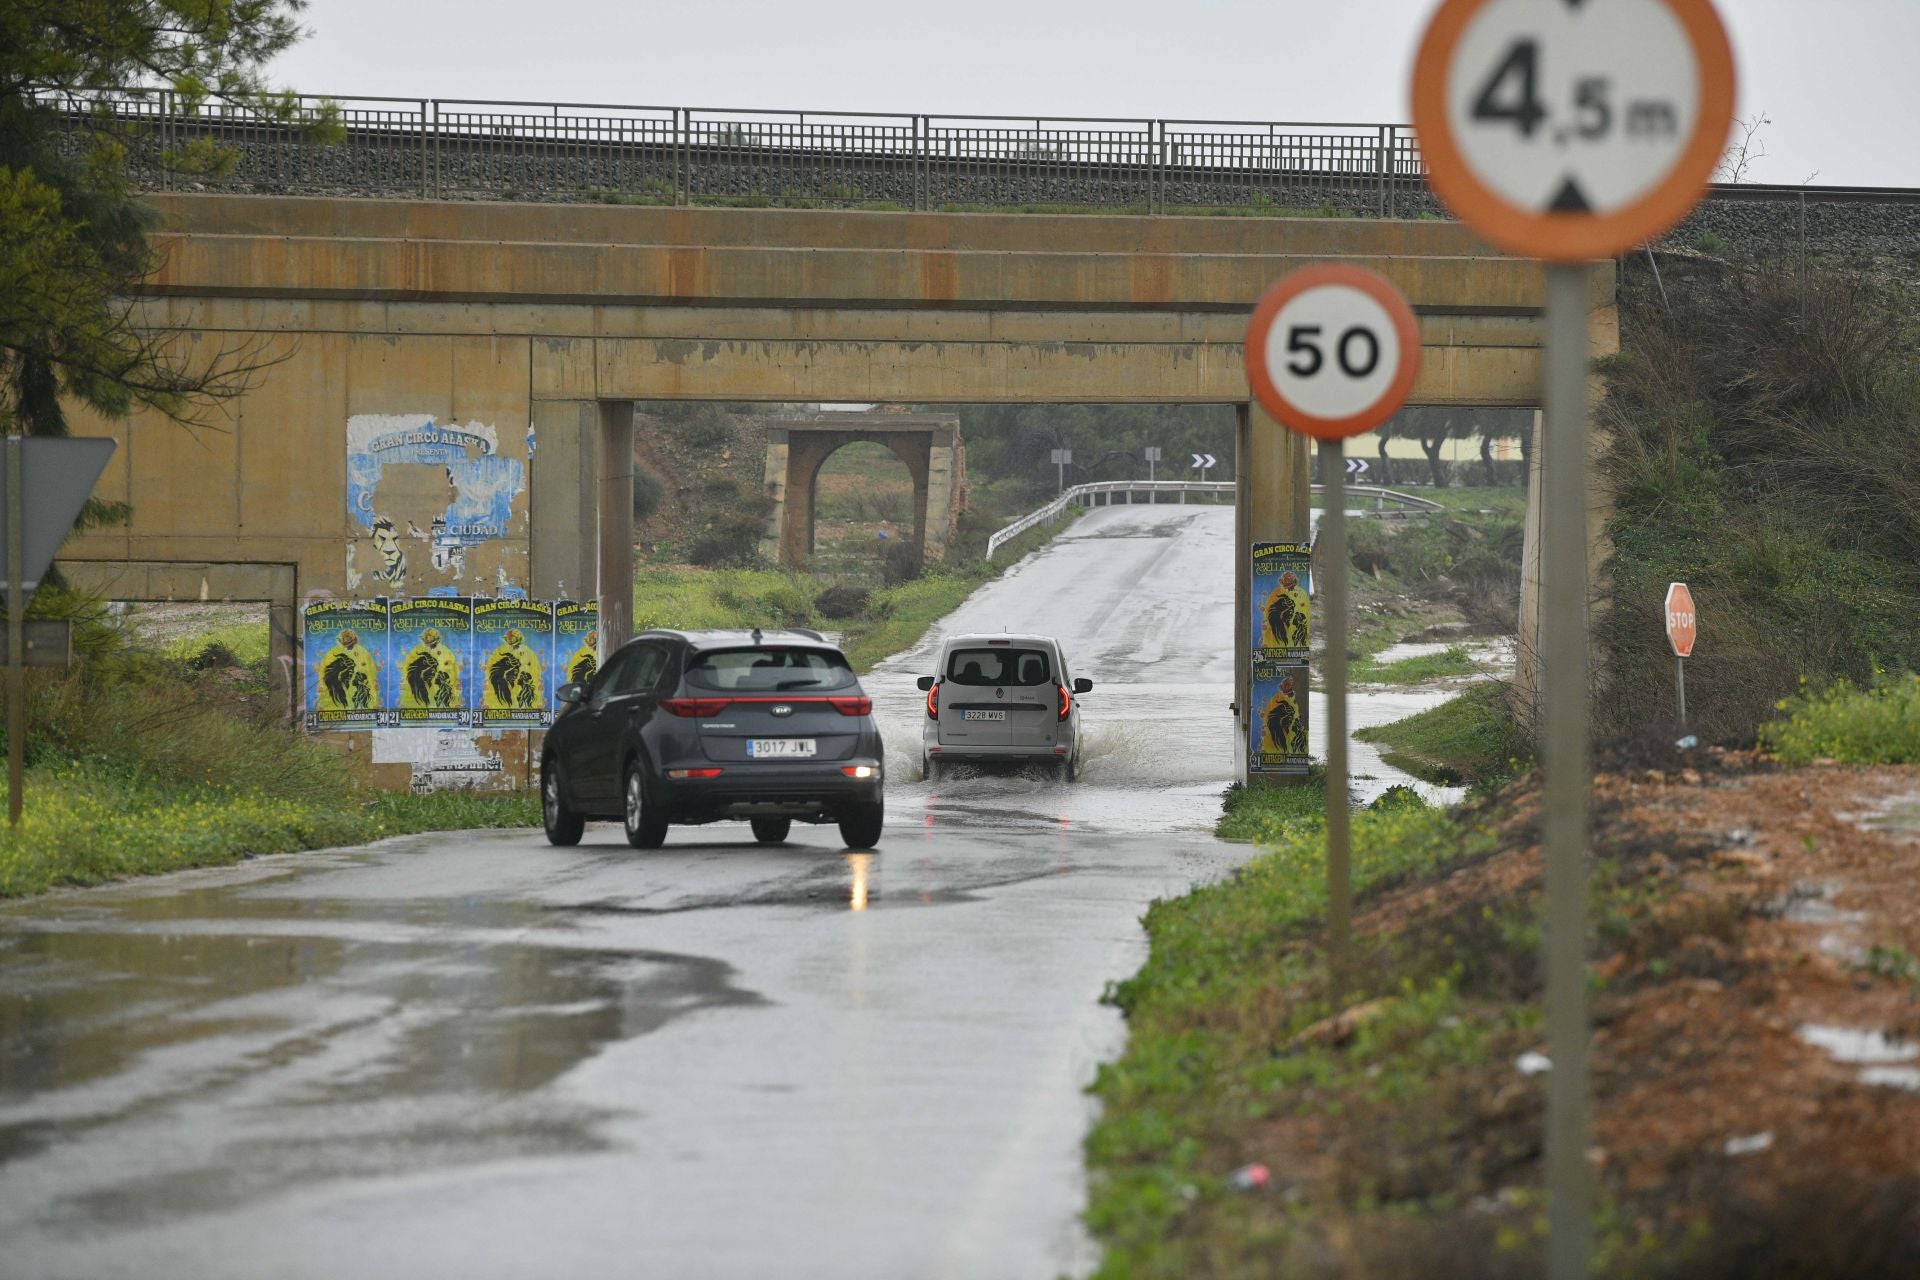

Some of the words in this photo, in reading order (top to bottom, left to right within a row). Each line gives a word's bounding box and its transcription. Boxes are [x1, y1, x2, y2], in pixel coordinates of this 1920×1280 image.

[1288, 325, 1381, 379] 50
[372, 434, 404, 452] GRAN
[407, 431, 439, 443] CIRCO
[450, 524, 499, 535] CIUDAD
[1254, 546, 1274, 558] GRAN
[1275, 544, 1295, 553] CIRCO
[1256, 562, 1285, 575] BELLA
[306, 602, 330, 617] GRAN
[391, 602, 414, 614] GRAN
[414, 600, 438, 609] CIRCO
[438, 600, 471, 615] ALASKA
[474, 603, 497, 615] GRAN
[497, 601, 521, 610] CIRCO
[557, 603, 579, 616] GRAN
[309, 619, 343, 634] BELLA
[351, 618, 386, 633] BESTIA
[393, 618, 427, 632] BELLA
[434, 618, 469, 631] BESTIA
[476, 618, 510, 633] BELLA
[517, 619, 552, 633] BESTIA
[559, 620, 593, 635] BELLA
[1671, 612, 1694, 629] STOP
[306, 712, 318, 727] 21
[318, 710, 347, 722] CARTAGENA
[347, 711, 377, 721] MANDARACHE
[377, 710, 388, 724] 30
[389, 710, 400, 724] 21
[400, 709, 429, 721] CARTAGENA
[429, 711, 458, 720] MANDARACHE
[458, 710, 470, 725] 30
[472, 711, 483, 725] 21
[484, 709, 512, 721] CARTAGENA
[512, 711, 541, 721] MANDARACHE
[540, 711, 552, 725] 30
[967, 711, 986, 719] 3228
[988, 711, 1003, 719] MVS
[755, 741, 786, 753] 3017
